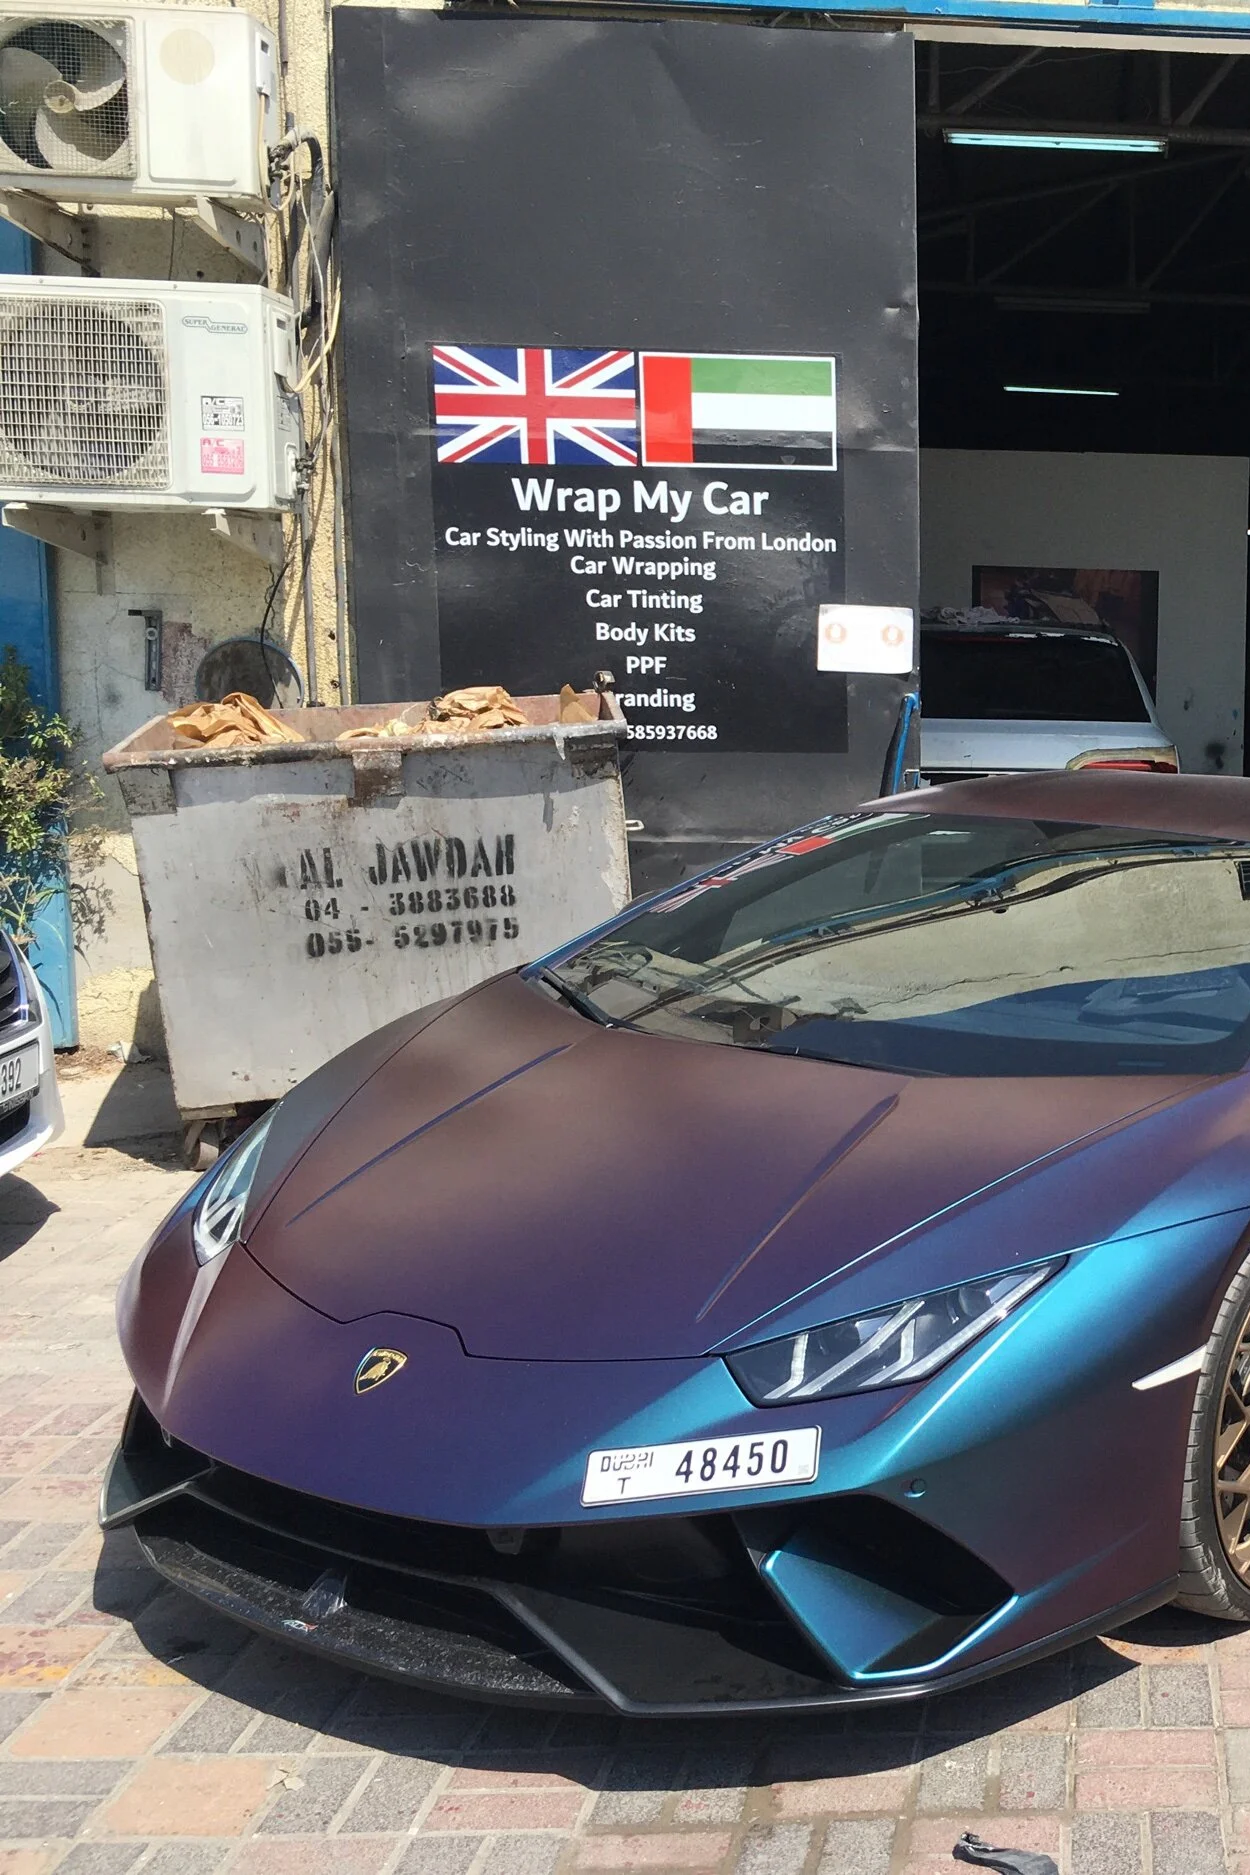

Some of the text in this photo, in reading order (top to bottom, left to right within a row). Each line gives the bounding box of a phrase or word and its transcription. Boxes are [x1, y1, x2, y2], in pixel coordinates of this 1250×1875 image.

[512, 478, 769, 522] Wrap My Car
[445, 527, 836, 552] Car Styling With Passion From London
[571, 556, 716, 580] Car Wrapping
[586, 589, 703, 613] Car Tinting
[596, 622, 696, 646] Body Kits
[626, 656, 667, 674] PPF
[615, 688, 696, 712] randing
[627, 725, 718, 740] 585937668
[368, 834, 515, 885] JAWDAH
[305, 898, 339, 921] 04
[389, 884, 516, 916] 3883688
[394, 917, 520, 949] 5297975
[674, 1439, 789, 1484] 48450
[617, 1476, 631, 1494] T
